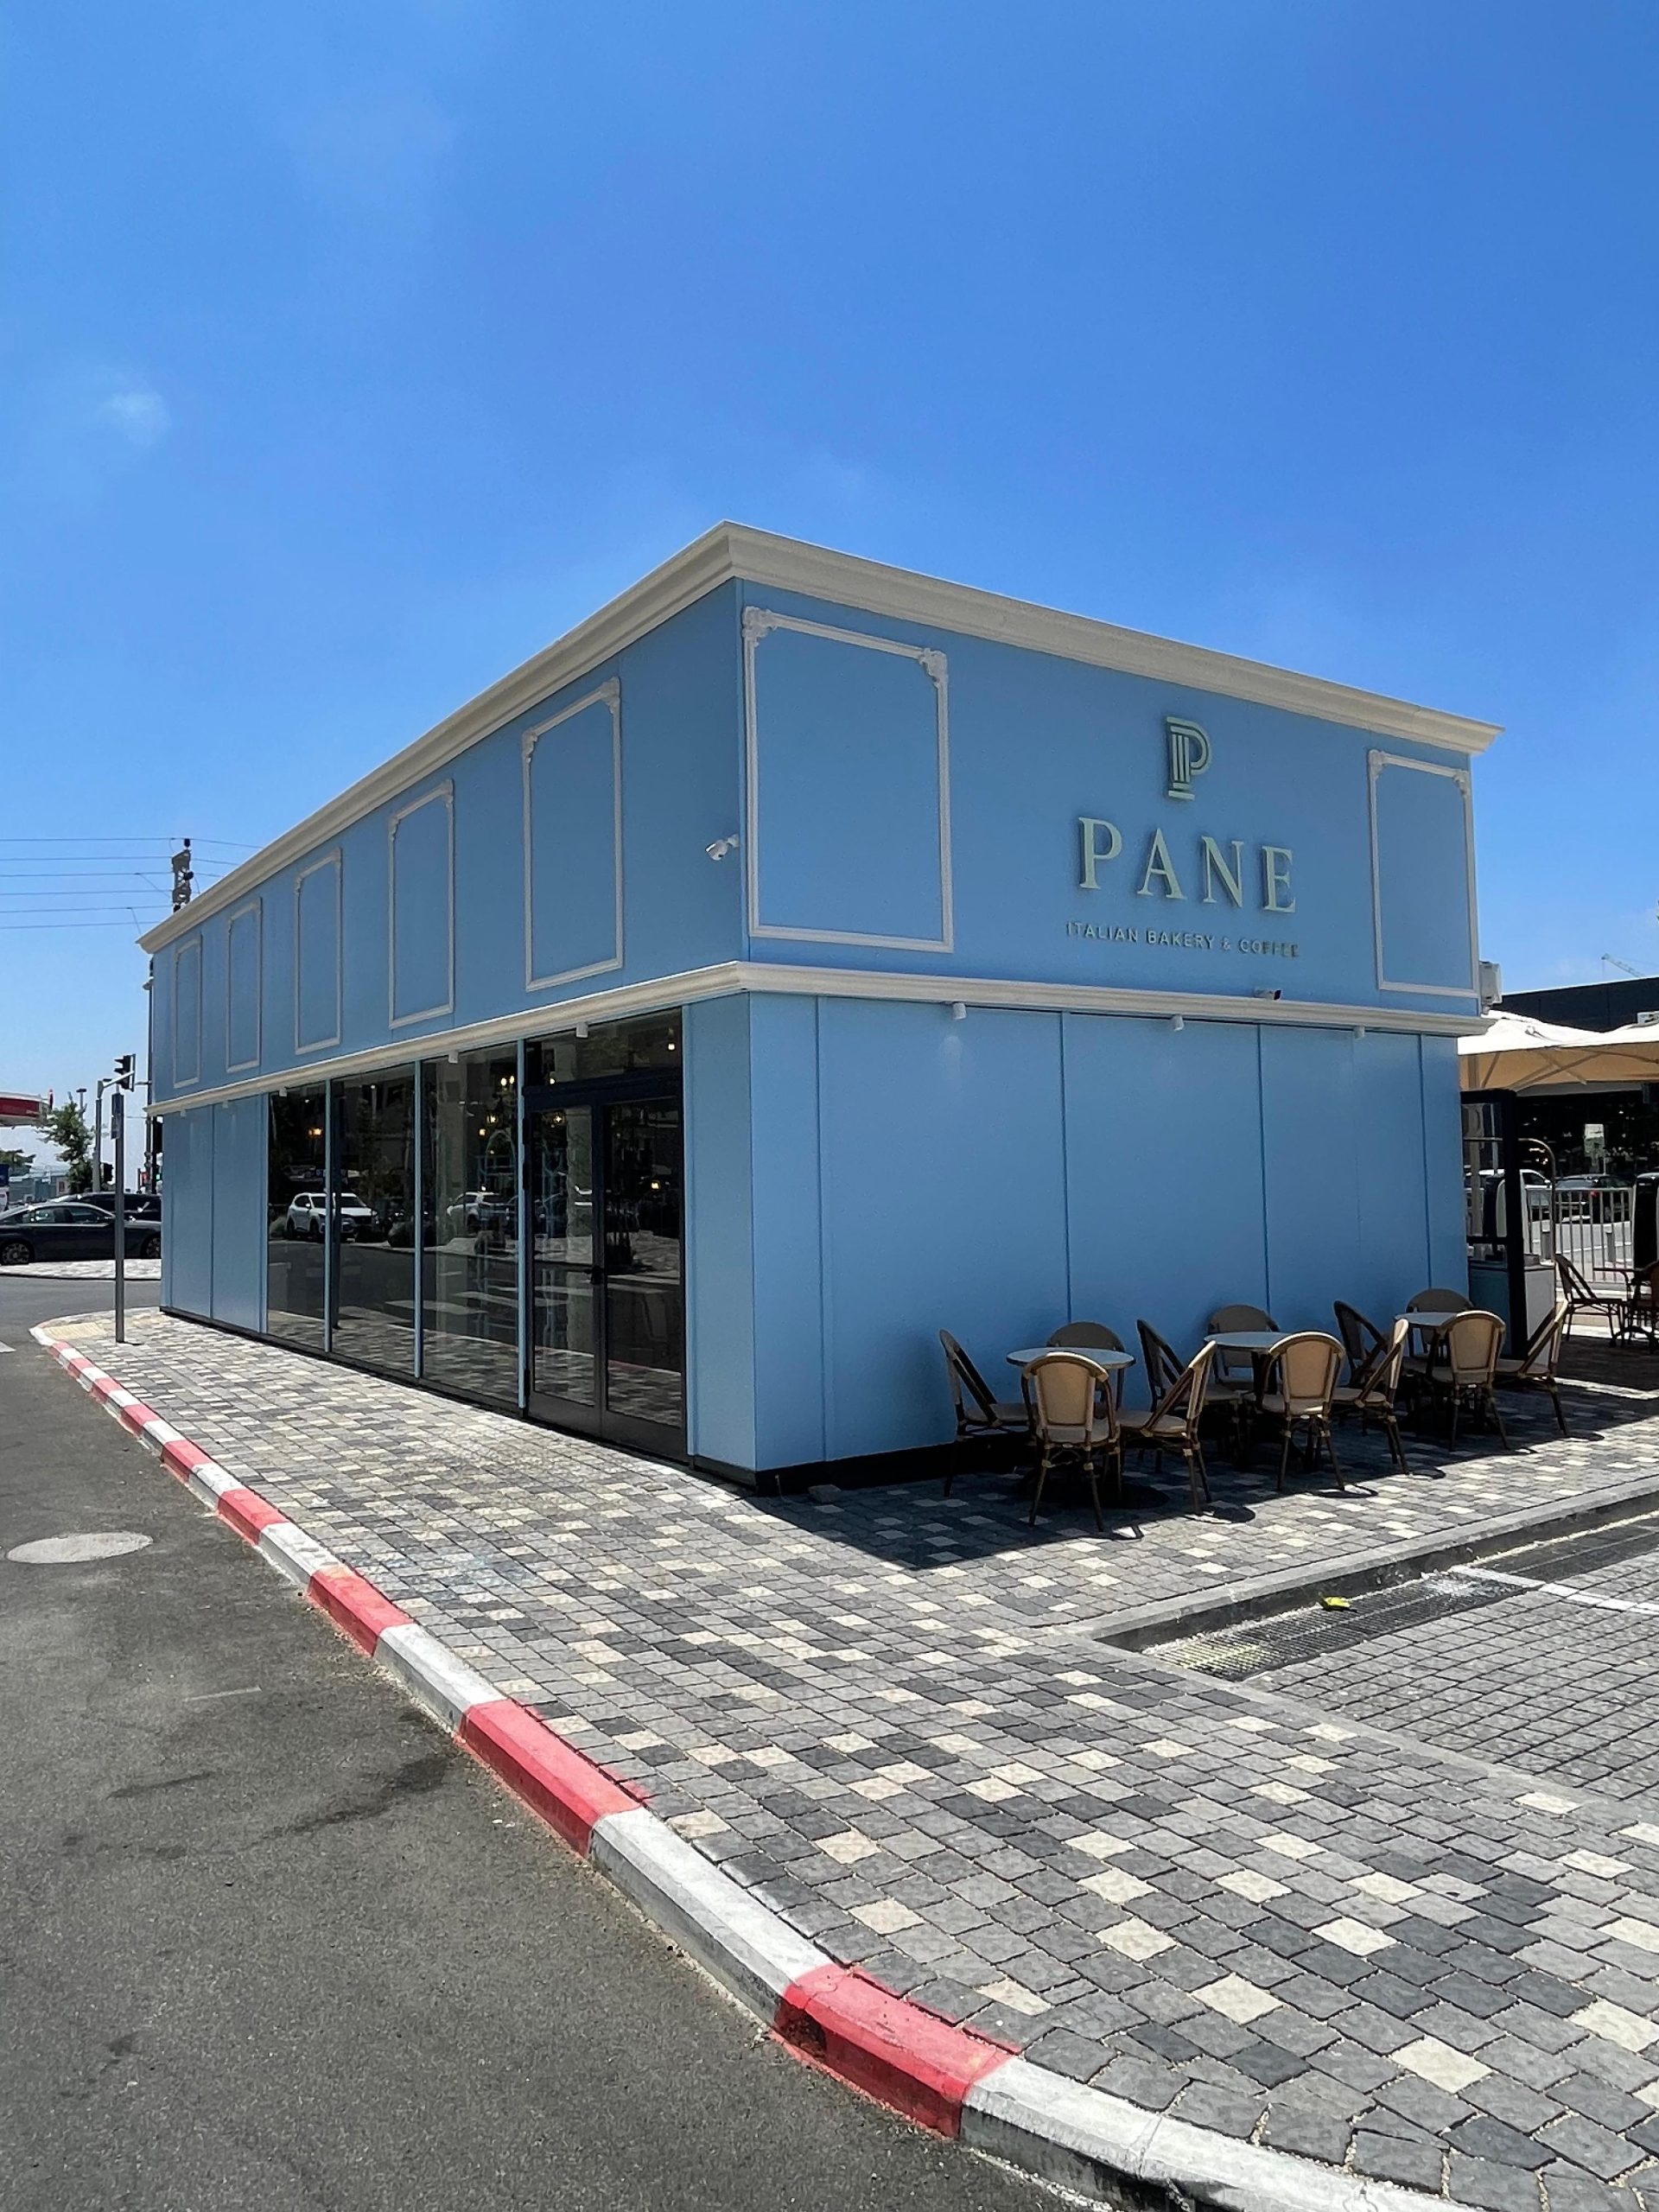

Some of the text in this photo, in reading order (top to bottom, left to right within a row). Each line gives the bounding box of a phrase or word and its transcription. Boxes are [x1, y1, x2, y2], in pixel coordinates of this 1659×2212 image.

[1077, 816, 1296, 913] PANE
[1066, 921, 1138, 943] ITALIAN
[1146, 929, 1215, 950] BAKERY
[1221, 936, 1231, 951] &
